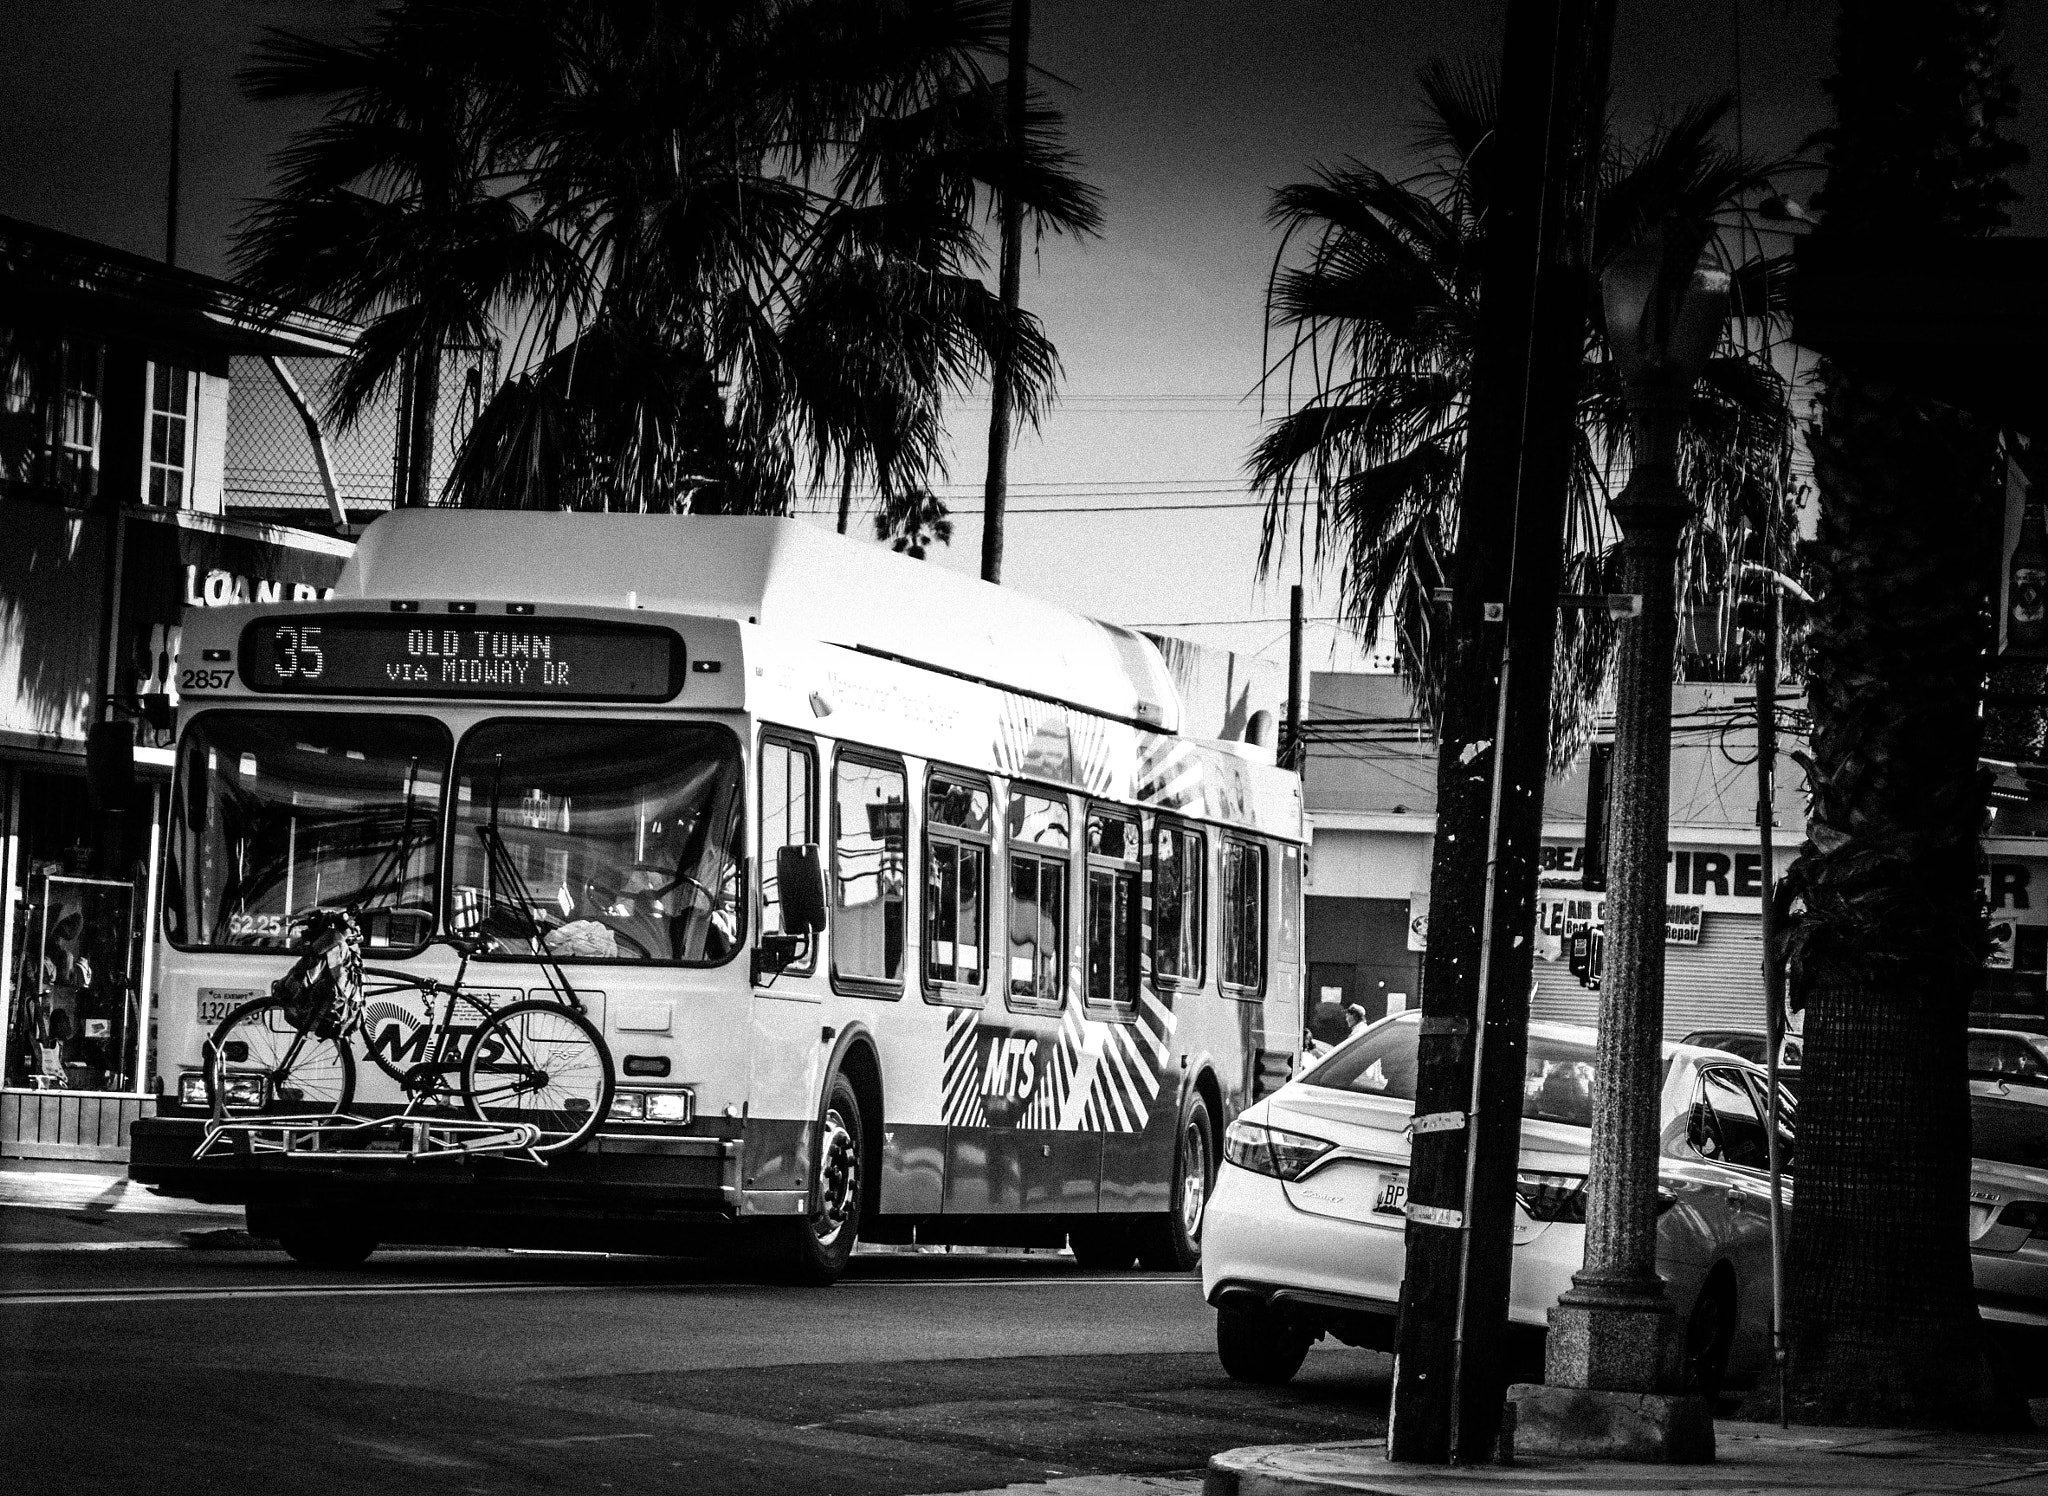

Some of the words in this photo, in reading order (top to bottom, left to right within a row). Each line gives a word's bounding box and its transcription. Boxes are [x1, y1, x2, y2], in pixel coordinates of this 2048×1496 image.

[187, 564, 281, 607] LOAN
[275, 625, 323, 678] 35
[408, 629, 459, 656] OLD
[474, 630, 551, 658] TOWN
[181, 669, 235, 689] 2857
[386, 663, 428, 681] VIA
[442, 658, 529, 684] MIDWAY
[543, 661, 569, 685] DR
[1666, 850, 1763, 898] IRE
[1567, 900, 1592, 920] AIR
[229, 913, 282, 937] $2.25
[1666, 925, 1699, 942] Repair
[362, 1023, 506, 1064] MTS
[980, 1036, 1039, 1099] MTS
